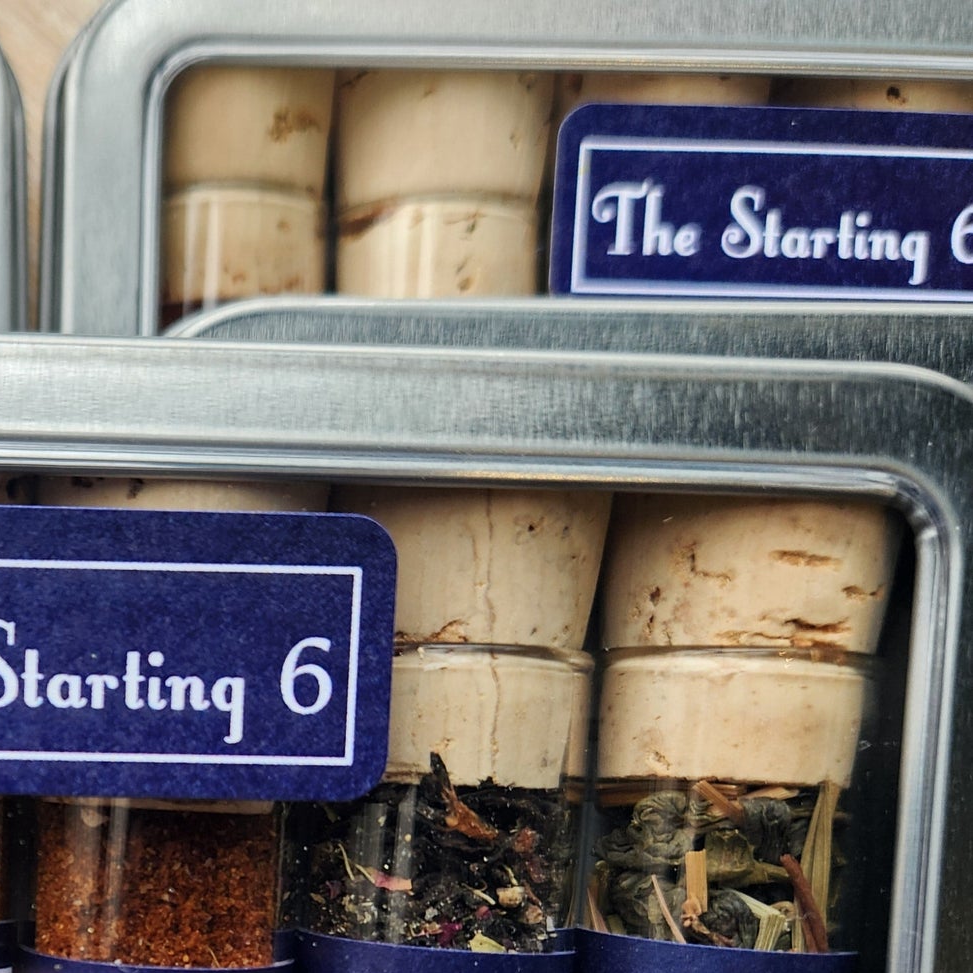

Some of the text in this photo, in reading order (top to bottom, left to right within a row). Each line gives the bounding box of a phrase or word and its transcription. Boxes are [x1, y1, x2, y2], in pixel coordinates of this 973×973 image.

[591, 177, 702, 258] The
[721, 184, 931, 286] Starting
[279, 636, 333, 716] 6
